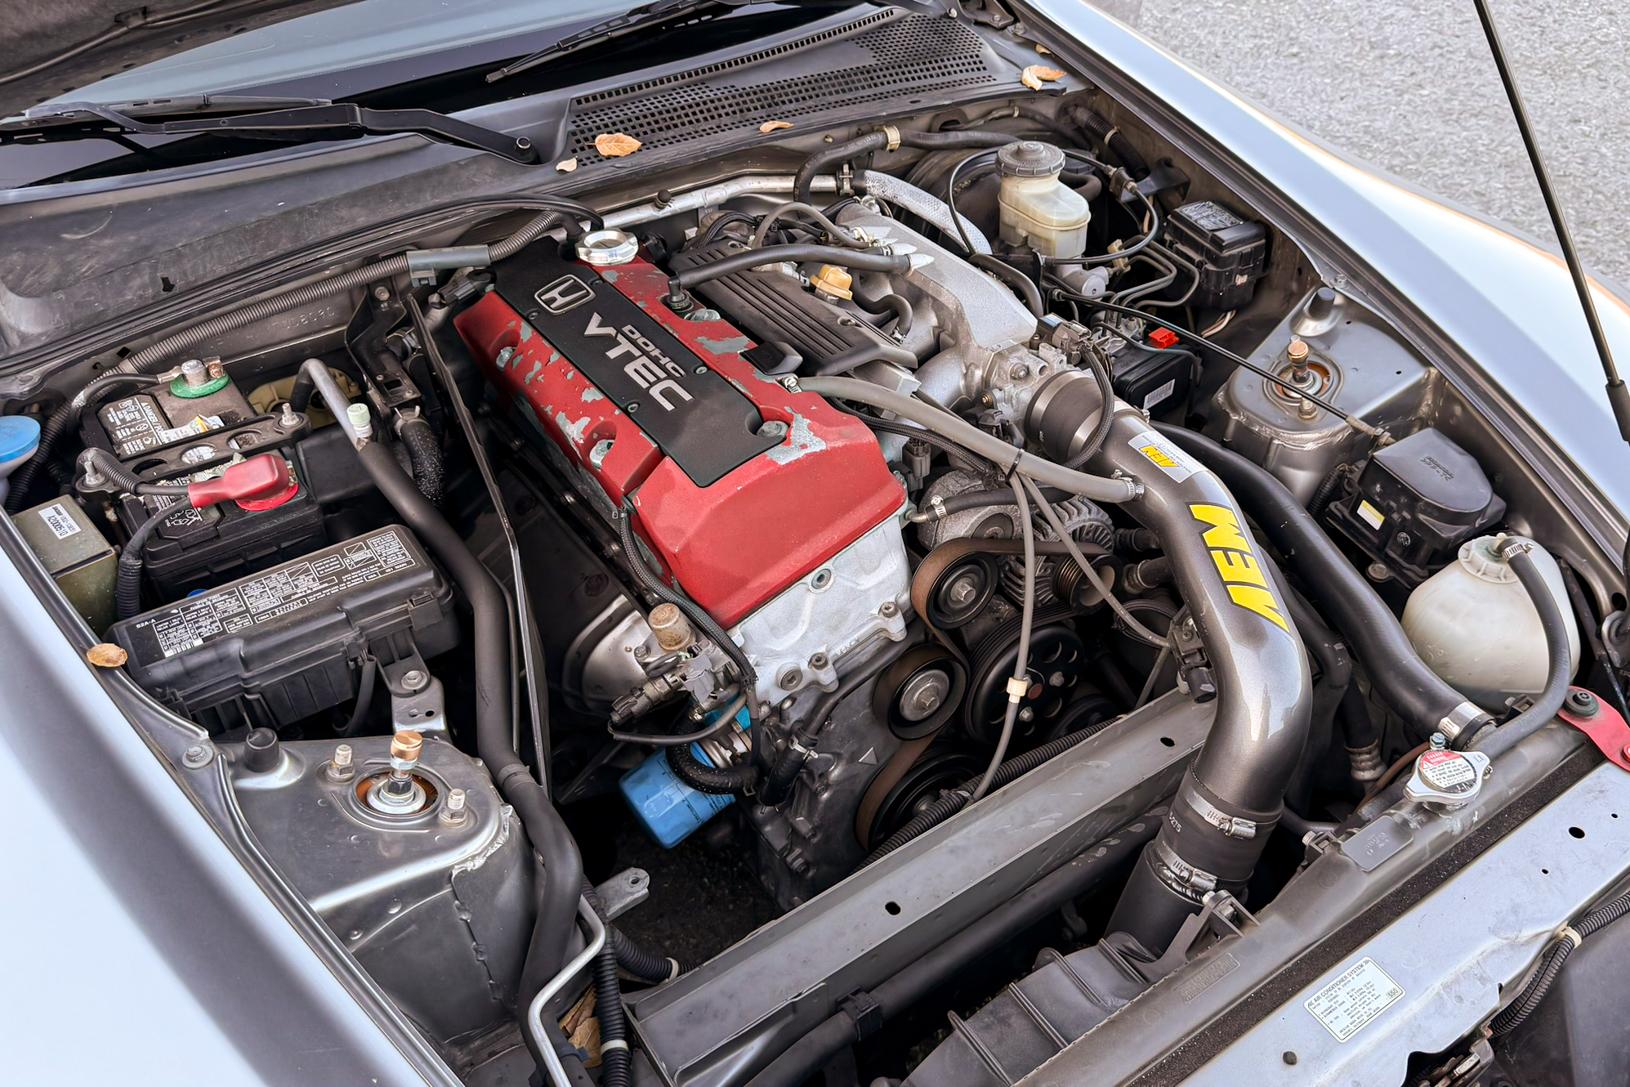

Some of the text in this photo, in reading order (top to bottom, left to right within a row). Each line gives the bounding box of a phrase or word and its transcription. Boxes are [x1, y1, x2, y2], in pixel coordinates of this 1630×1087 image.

[584, 312, 695, 411] VTEC
[622, 325, 686, 377] DOHC
[1188, 503, 1290, 633] AEM
